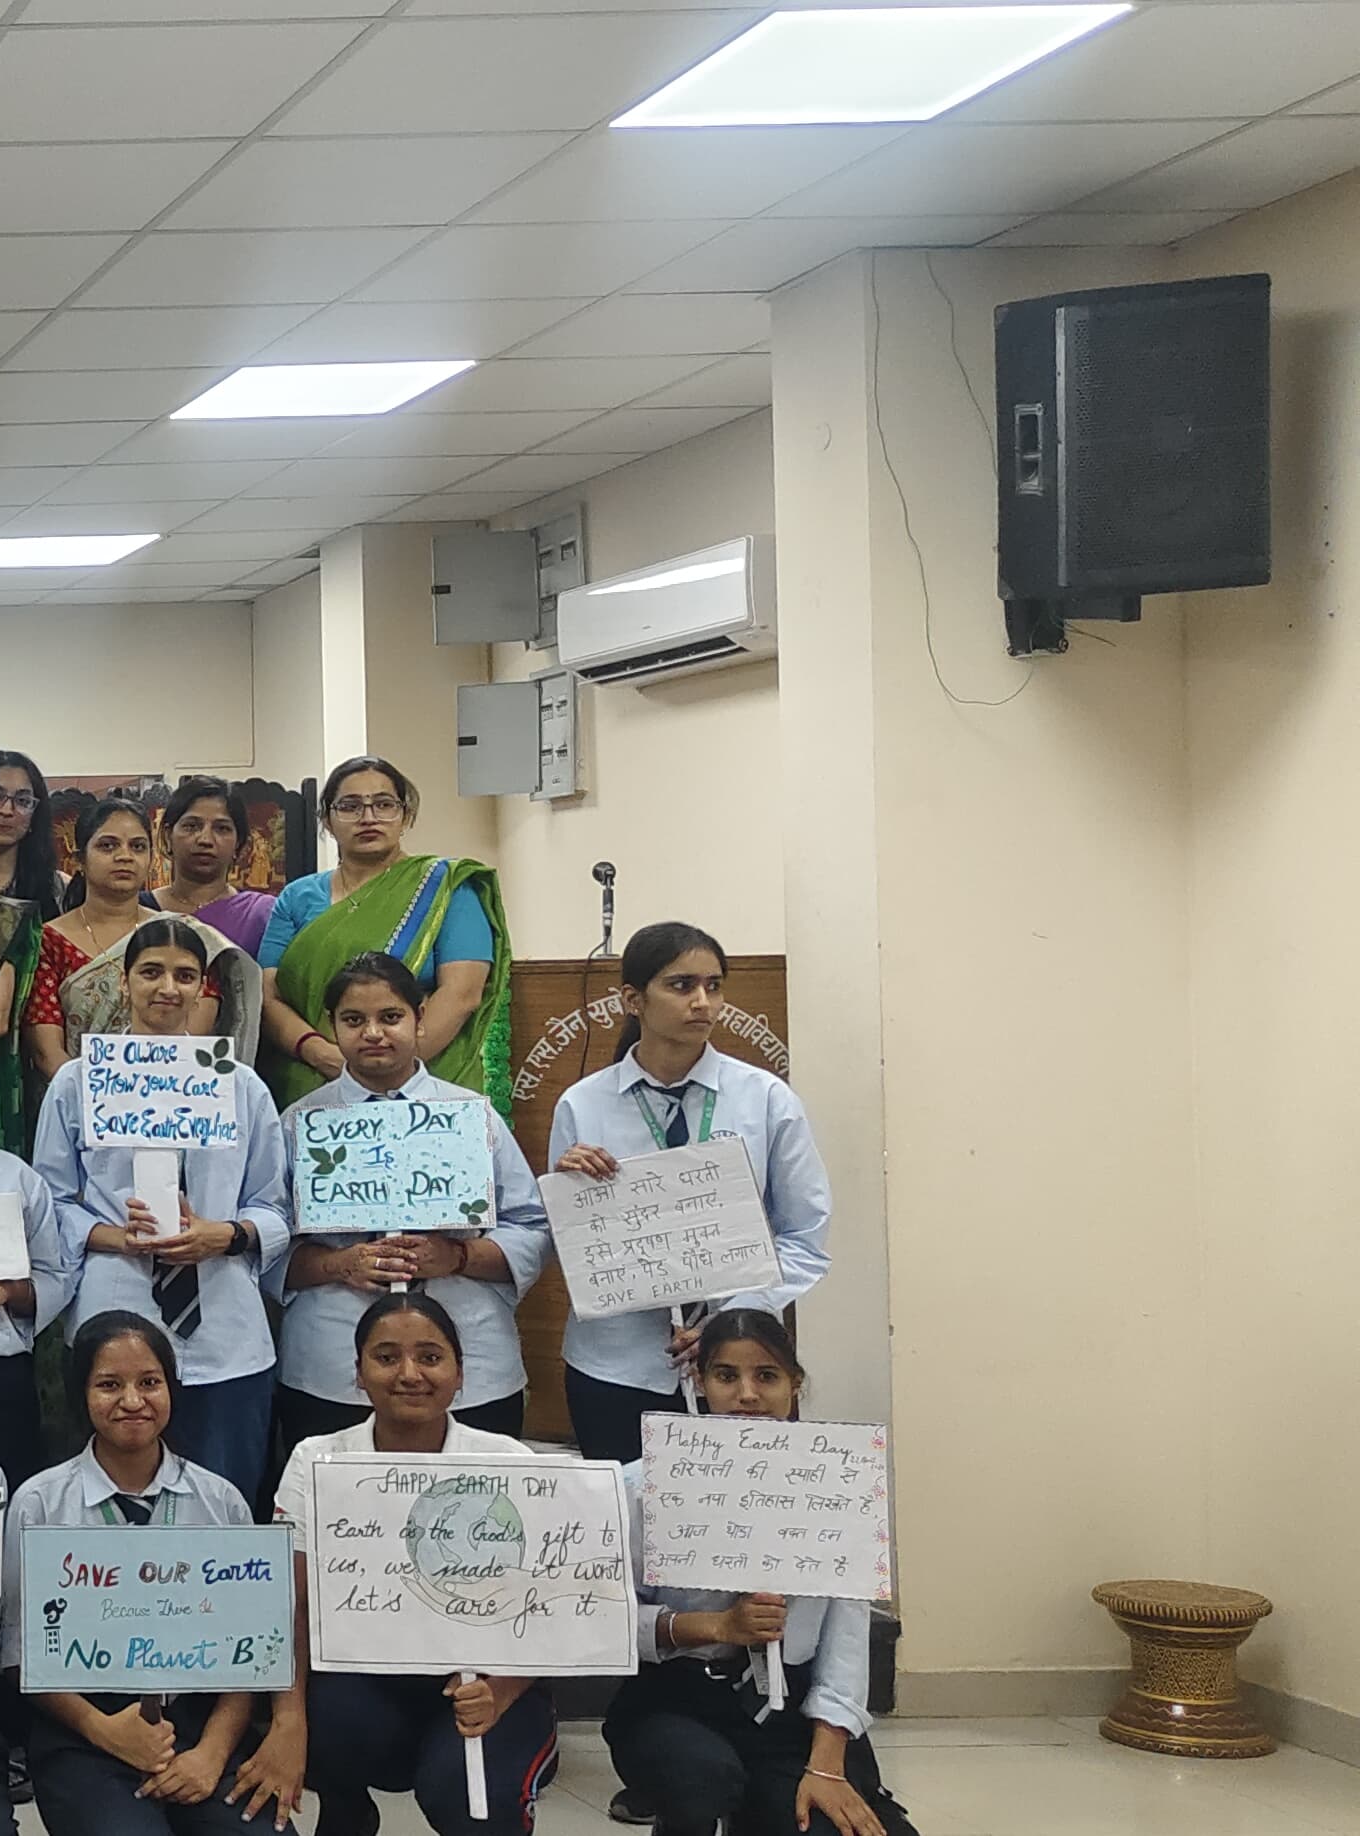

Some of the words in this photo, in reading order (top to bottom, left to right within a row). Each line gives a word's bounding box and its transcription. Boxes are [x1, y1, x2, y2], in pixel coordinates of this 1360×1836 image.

[429, 1519, 456, 1541] the
[58, 1552, 122, 1588] SAVE
[138, 1561, 191, 1584] OUR
[64, 1637, 112, 1670] No
[126, 1637, 218, 1670] Planet
